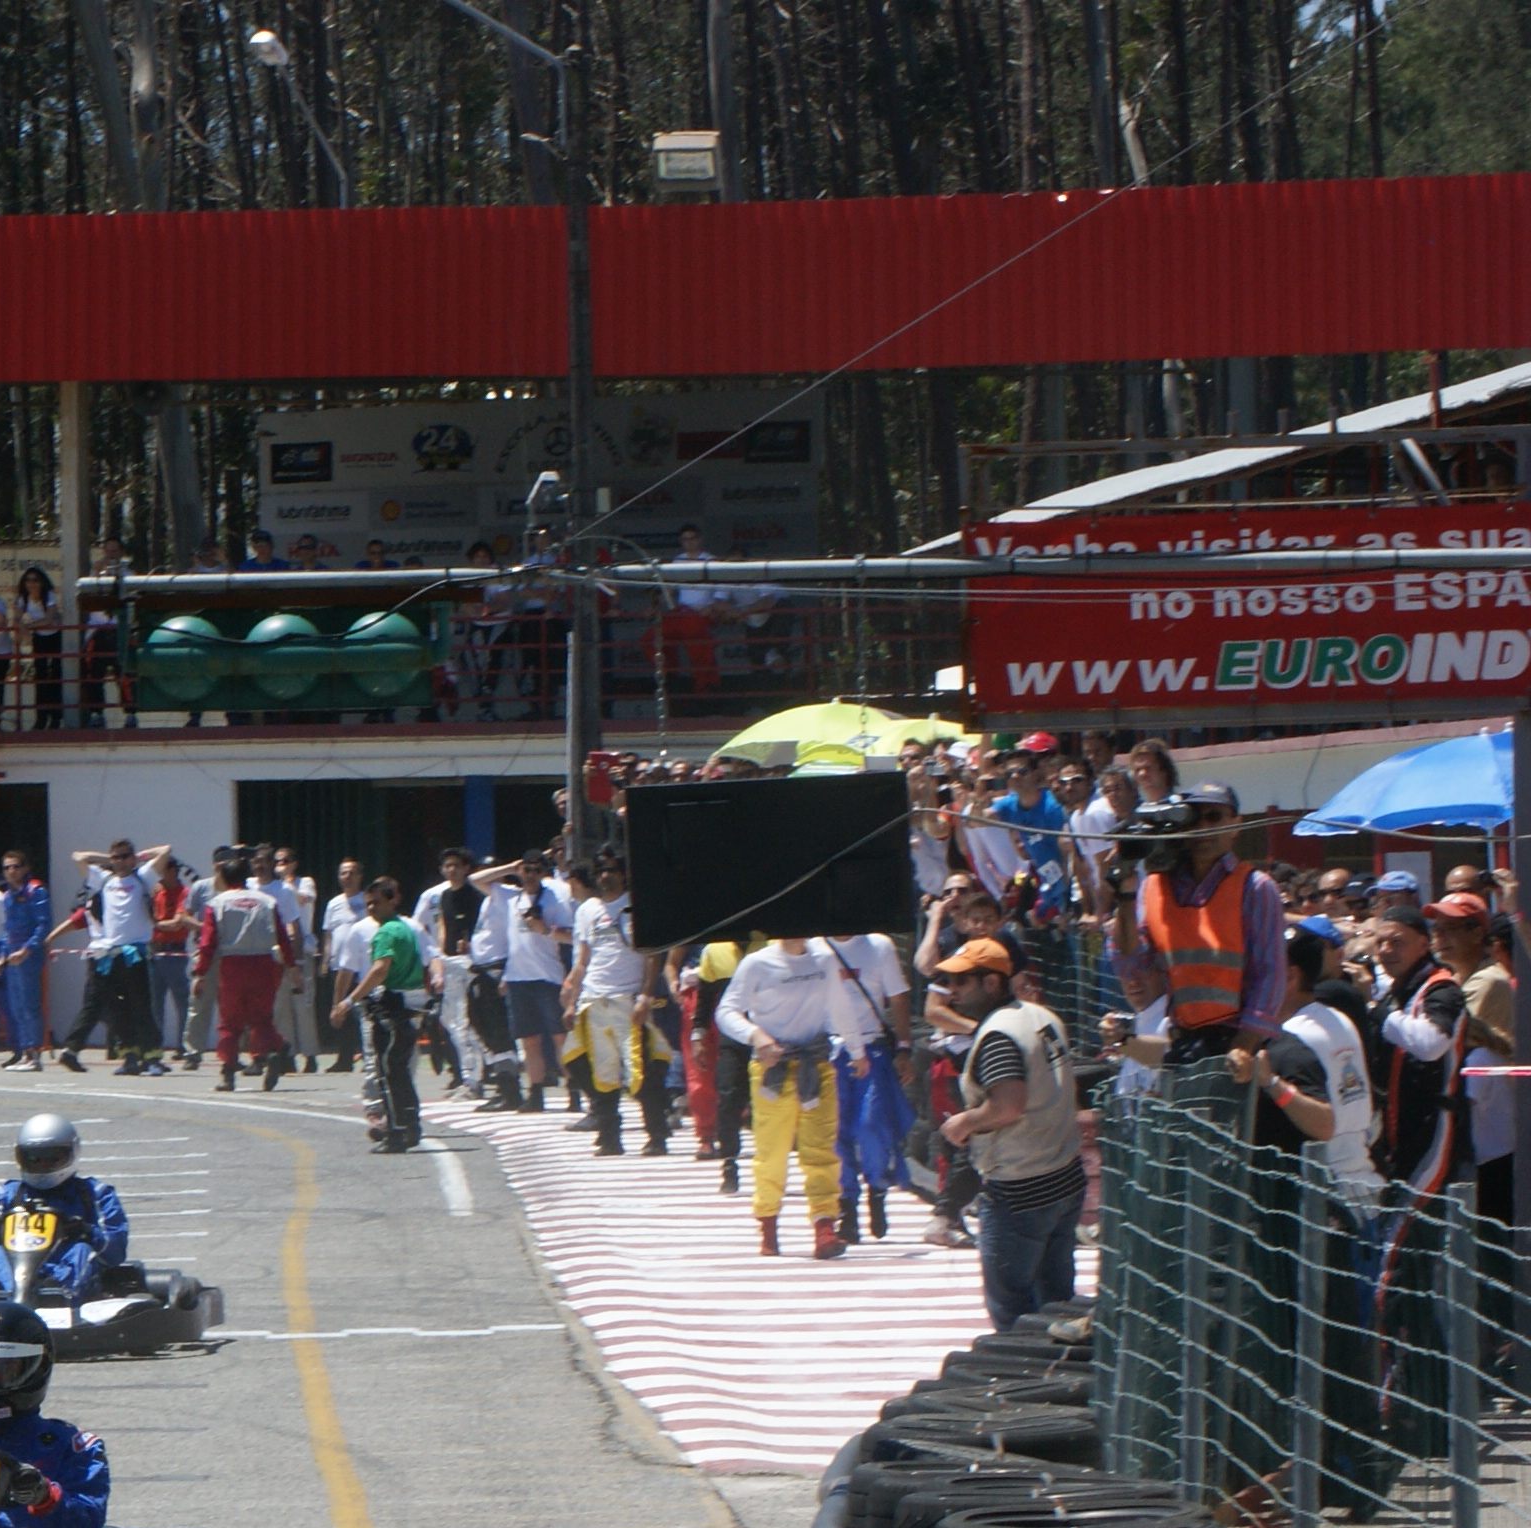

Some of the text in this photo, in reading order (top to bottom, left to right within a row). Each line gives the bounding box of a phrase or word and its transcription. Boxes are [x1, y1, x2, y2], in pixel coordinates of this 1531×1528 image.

[421, 427, 459, 452] 24
[339, 452, 399, 464] HONDA
[1129, 591, 1195, 620] no
[1213, 585, 1376, 618] nosso
[1006, 629, 1531, 696] www.EUROIND
[10, 1212, 45, 1234] 144
